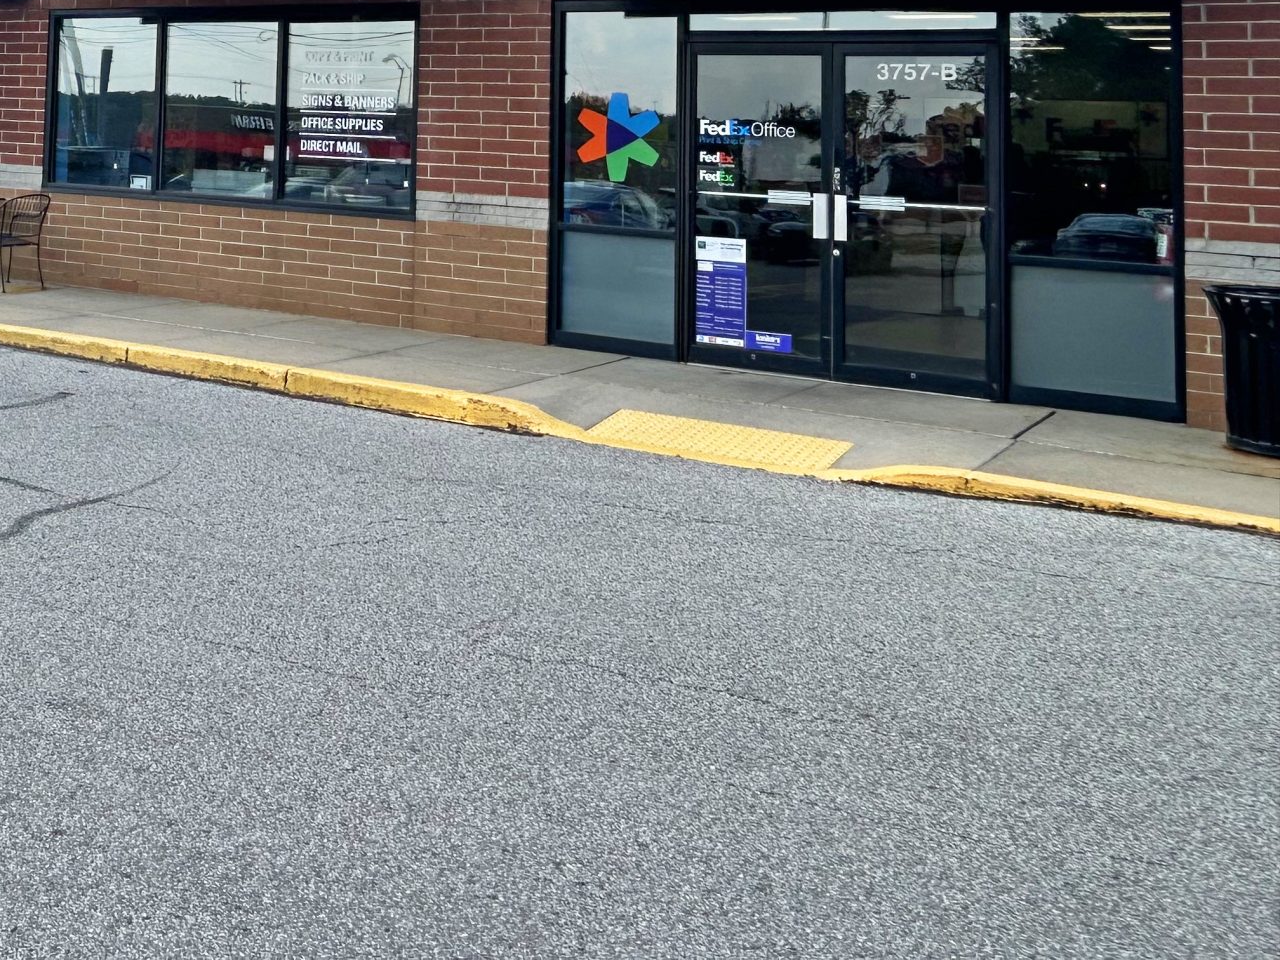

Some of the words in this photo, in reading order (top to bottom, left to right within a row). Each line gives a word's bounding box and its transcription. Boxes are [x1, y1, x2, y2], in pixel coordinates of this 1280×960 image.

[302, 72, 329, 85] PACK
[340, 73, 365, 85] SHIP
[877, 63, 958, 81] 3757-B
[302, 94, 332, 107] SIGNS
[334, 95, 343, 107] &
[344, 95, 395, 109] BANNERS
[301, 116, 334, 129] OFFICE
[335, 117, 384, 131] SUPPLIES
[699, 118, 750, 136] FedEx
[751, 121, 796, 138] Office
[300, 139, 335, 152] DIRECT
[336, 141, 363, 154] MAIL
[699, 151, 734, 163] FedEx
[699, 169, 734, 182] FedEx
